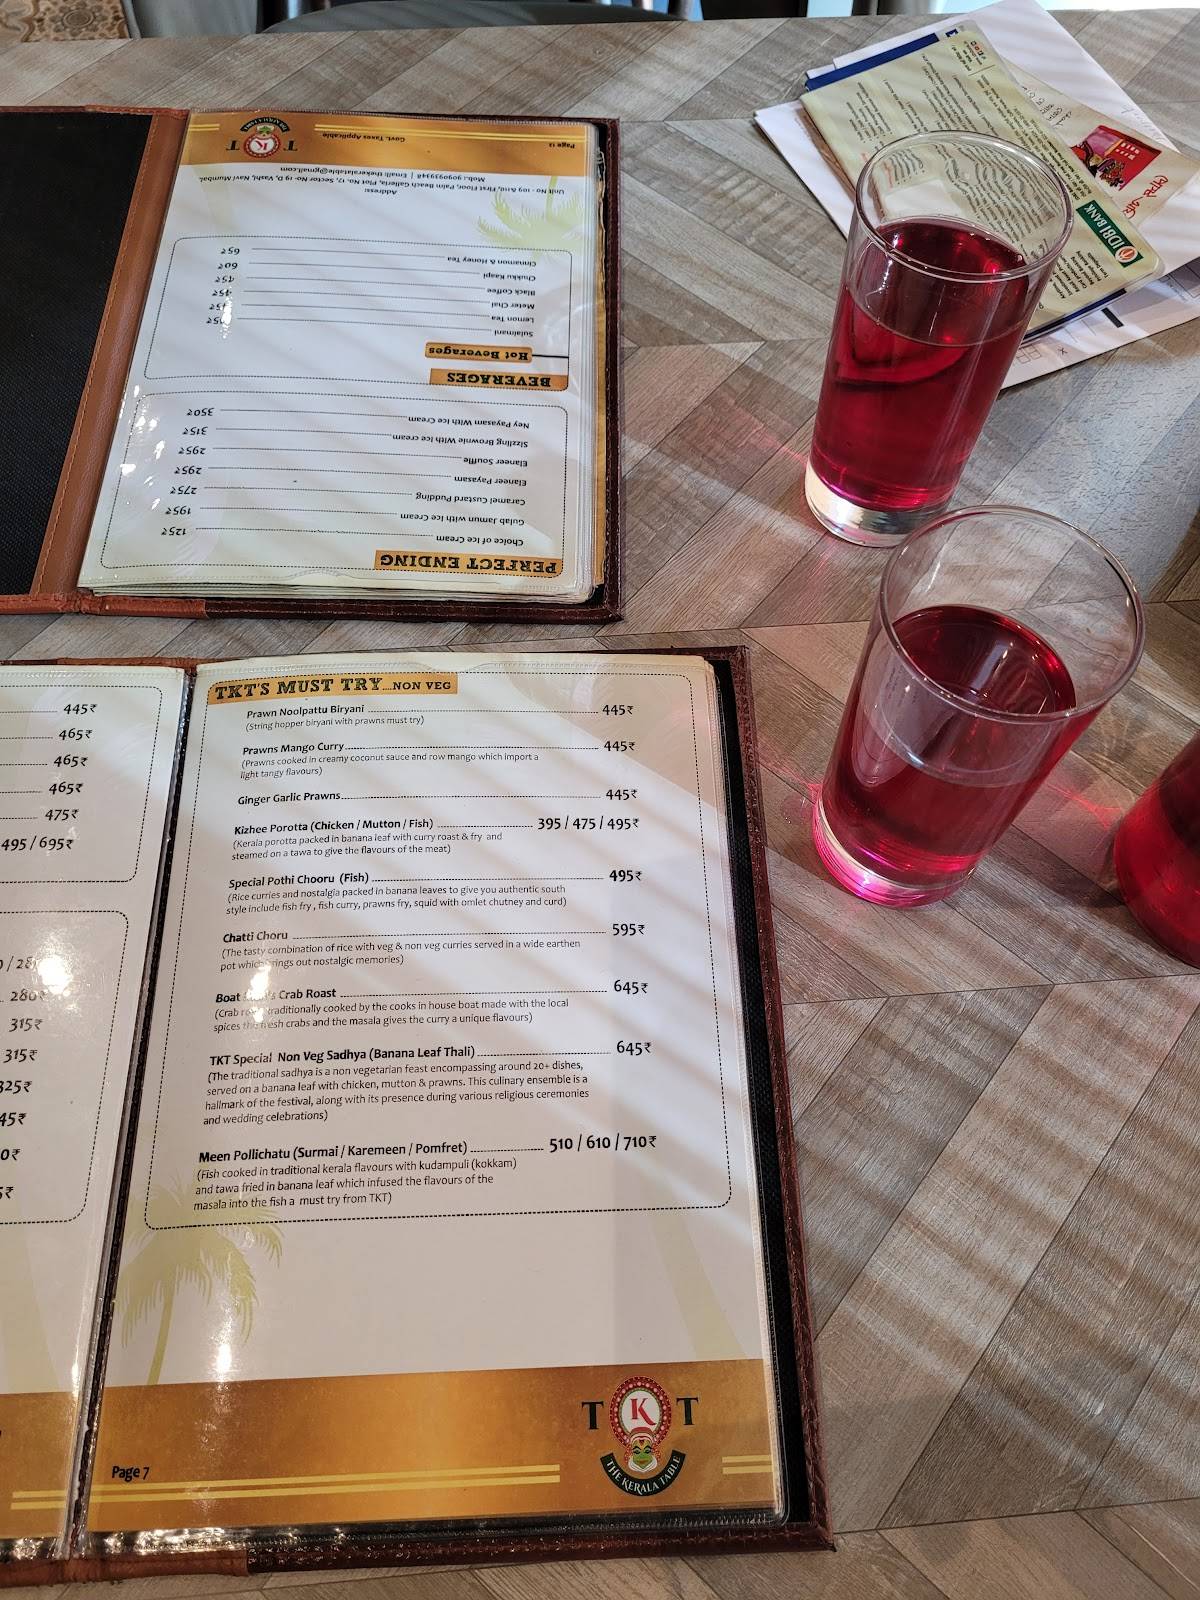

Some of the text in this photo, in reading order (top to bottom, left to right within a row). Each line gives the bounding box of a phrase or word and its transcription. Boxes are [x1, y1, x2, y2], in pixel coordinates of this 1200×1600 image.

[1082, 203, 1125, 251] IDBI BANK
[429, 346, 528, 361] Hot Beverages
[447, 372, 551, 387] BEVERAGES
[474, 420, 511, 428] Payasam
[513, 420, 529, 429] Ney
[458, 438, 494, 446] Brownie
[496, 438, 528, 448] Sizzling
[463, 457, 528, 467] Elaneer Souffle
[454, 476, 527, 487] Elaneer Payasam
[415, 492, 526, 506] Caramel Custard Pudding
[431, 514, 444, 522] Ice
[499, 518, 525, 526] Gulab
[436, 536, 524, 547] Choice of Ice Cream
[380, 554, 557, 574] PERFECT ENDING
[215, 682, 270, 700] TKT'S
[276, 678, 334, 695] MUST
[425, 680, 452, 691] VEG
[247, 705, 365, 718] Prawn Noolpattu Biryani
[243, 742, 344, 755] Prawns Mango Curry
[238, 792, 341, 806] Ginger Garlic Prawns
[234, 825, 268, 835] Kizhee
[270, 824, 308, 832] Porotta
[310, 821, 354, 832] (Chicken
[362, 820, 401, 829] Mutton
[409, 818, 433, 830] Fish)
[538, 818, 561, 830] 395
[572, 818, 596, 830] 475
[229, 872, 369, 889] Special Pothi Chooru (Fish)
[223, 931, 288, 943] Chatti Choru
[215, 993, 241, 1003] Boat
[279, 989, 303, 999] Crab
[306, 989, 337, 998] Roast
[209, 1045, 475, 1067] TKT Special Non Veg Sadhya (Banana Leaf Thali)
[203, 1110, 328, 1125] and wedding celebrations)
[549, 1138, 573, 1153] 510
[586, 1135, 611, 1149] 610
[199, 1152, 231, 1163] Meen
[233, 1148, 290, 1160] Pollichatu
[293, 1146, 339, 1161] (Surmai
[347, 1146, 406, 1156] Karemeen
[415, 1141, 467, 1155] Pomfret)
[193, 1192, 392, 1210] masala into the fish a must try from TKT)
[581, 1397, 699, 1430] T K T
[111, 1465, 150, 1482] Page 7
[605, 1455, 681, 1495] THE KERALA TABLE
